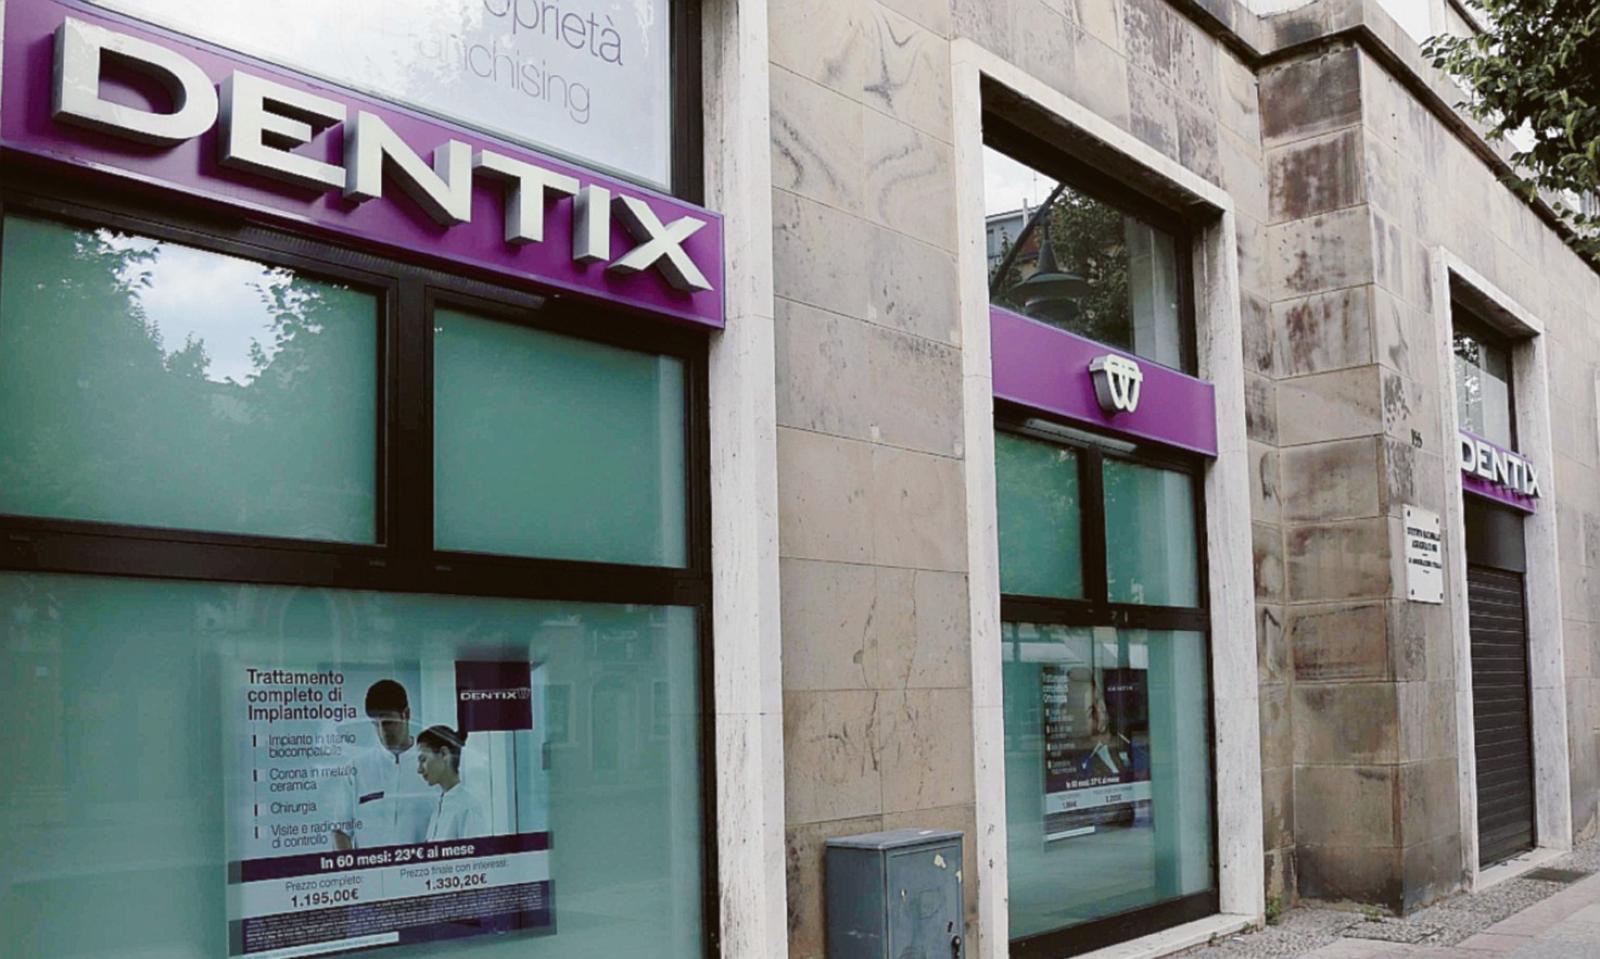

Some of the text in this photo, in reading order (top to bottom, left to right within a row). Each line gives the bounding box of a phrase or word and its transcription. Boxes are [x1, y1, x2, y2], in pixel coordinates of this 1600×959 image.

[53, 16, 714, 293] DENTIX
[1458, 432, 1543, 498] DENTIX
[246, 669, 344, 685] Trattamento
[248, 687, 342, 705] completo di
[460, 692, 517, 701] DENTIX
[248, 704, 357, 722] Implantologia
[269, 735, 312, 747] Impianto
[315, 734, 324, 745] in
[269, 767, 307, 780] Corona
[311, 766, 318, 778] in
[270, 780, 317, 792] ceramica
[270, 801, 317, 815] Chirurgia
[271, 823, 298, 836] Visite
[301, 824, 308, 834] e
[272, 834, 329, 848] di controllo
[321, 856, 333, 869] In
[336, 855, 354, 868] 60
[357, 850, 392, 866] mesi:
[427, 845, 439, 858] al
[442, 844, 475, 857] mese
[400, 867, 429, 878] Prezzo
[431, 864, 453, 875] finale
[455, 864, 471, 873] con
[286, 881, 317, 892] Prezzo
[425, 873, 487, 890] 1.330,20€
[291, 888, 358, 907] 1.195,00€
